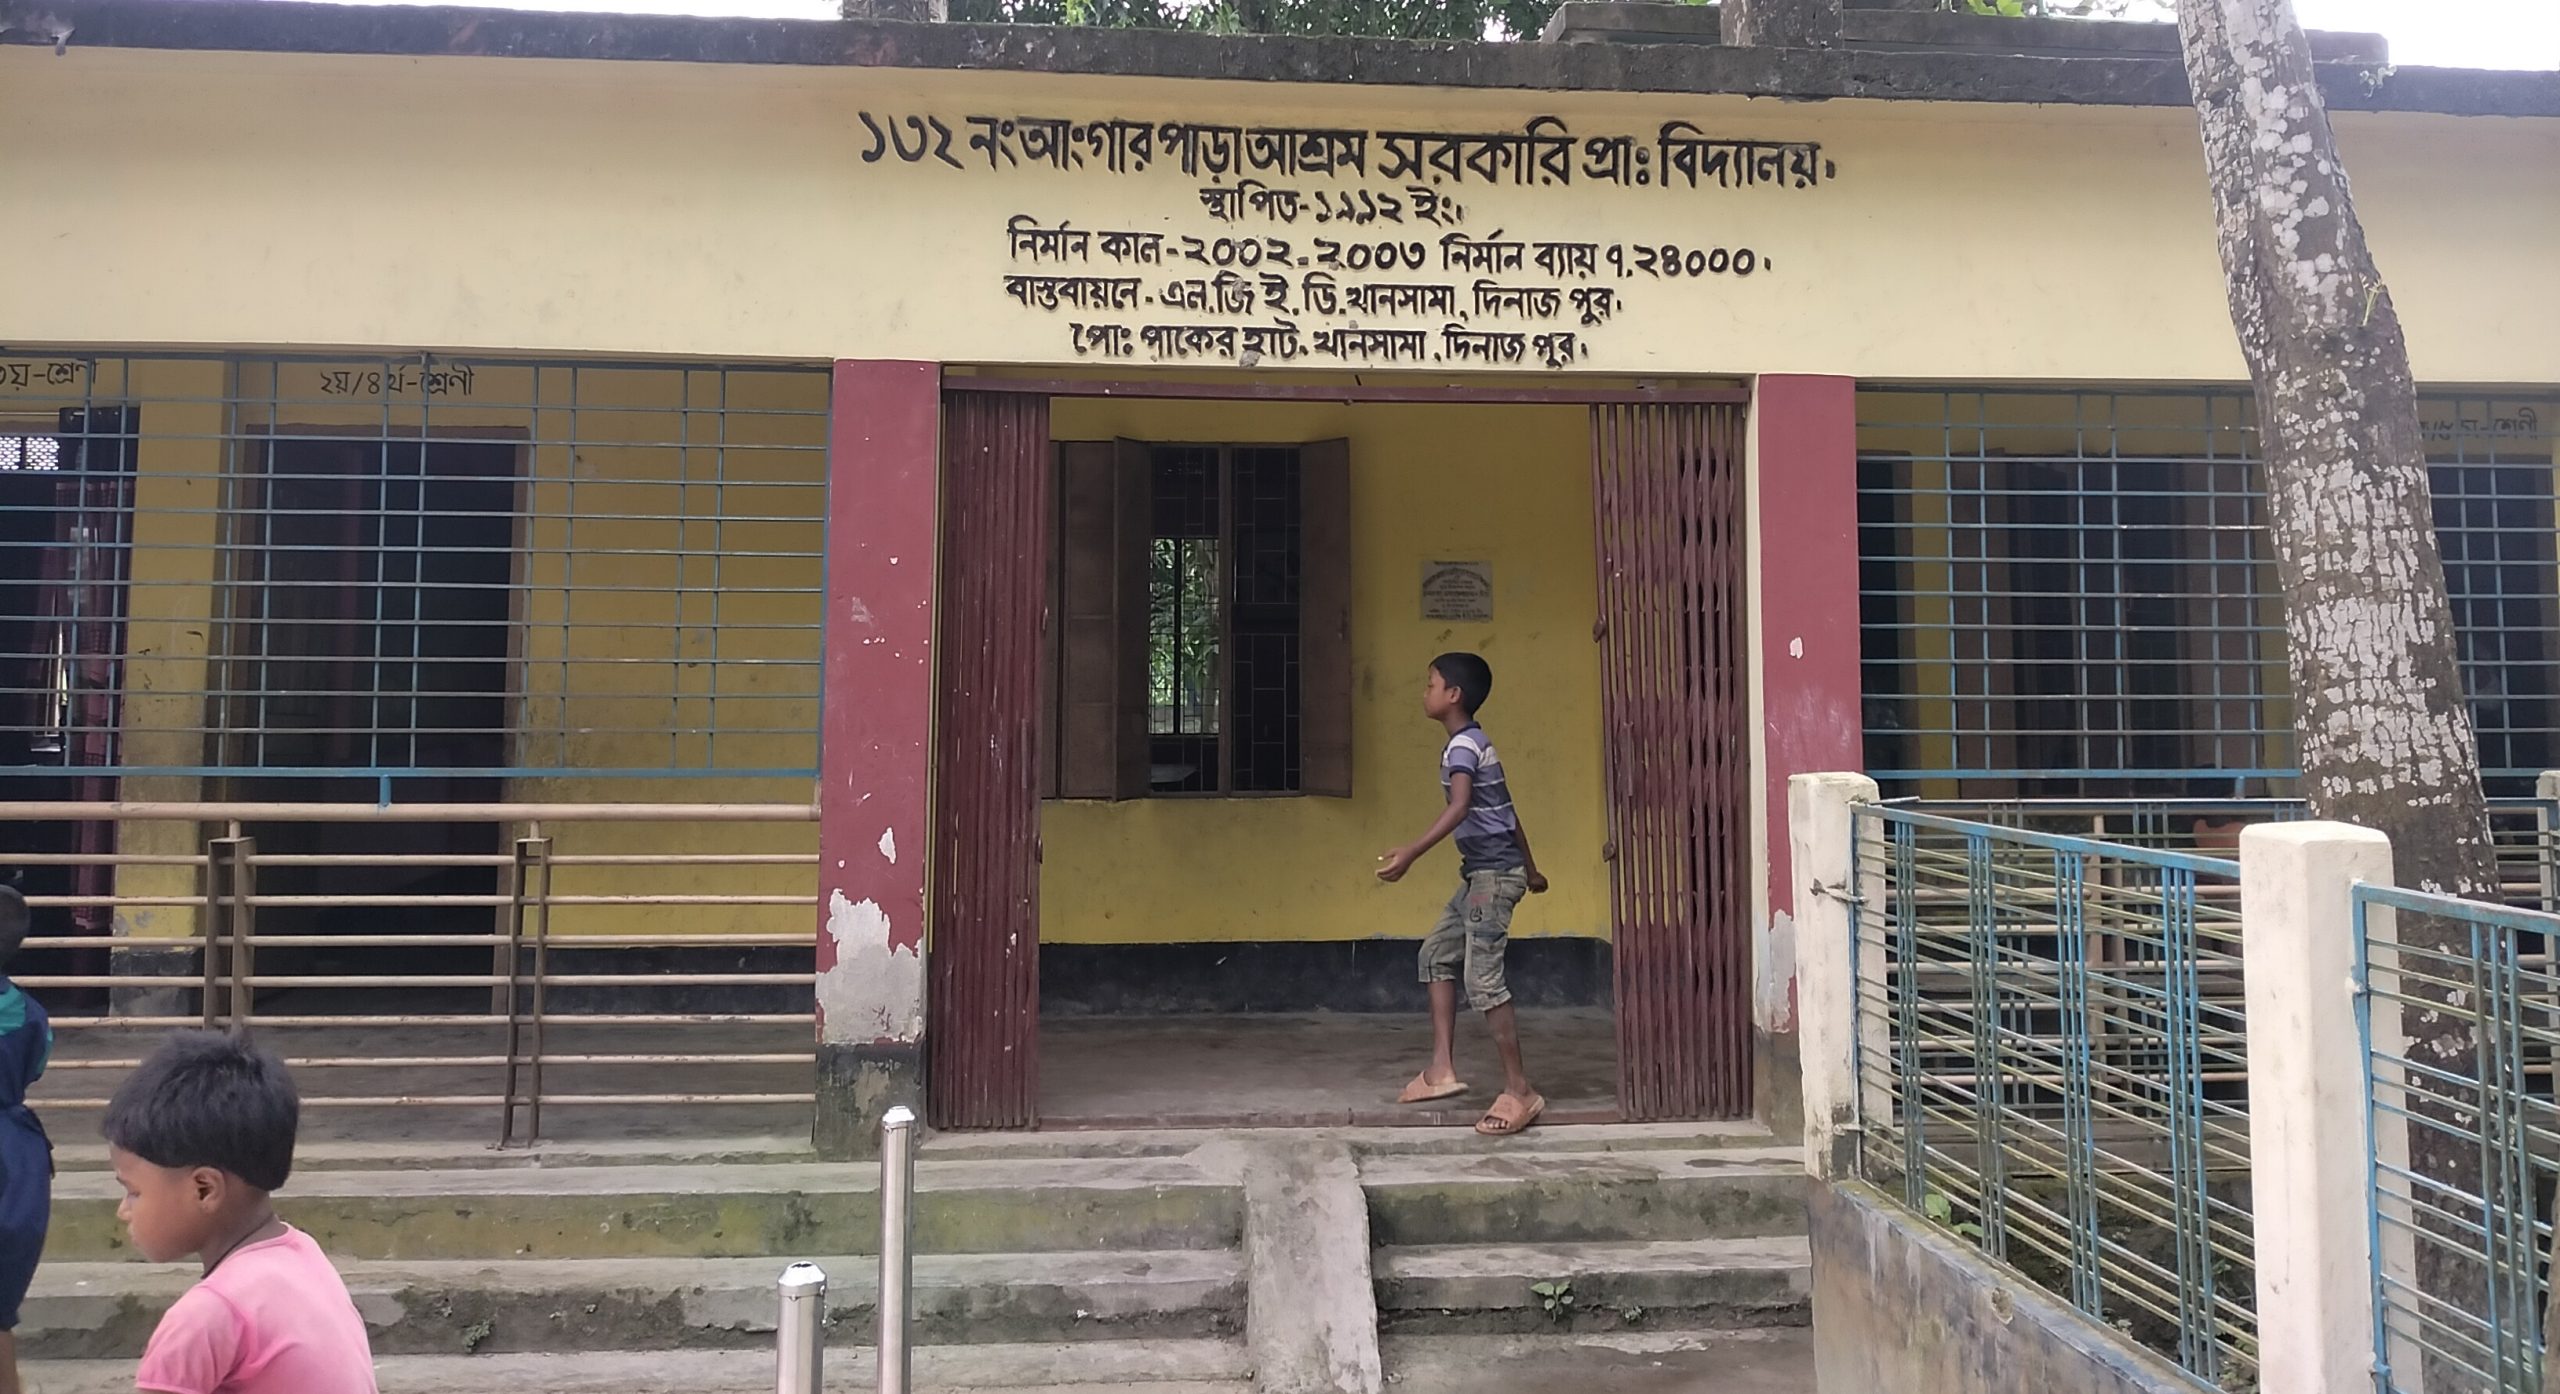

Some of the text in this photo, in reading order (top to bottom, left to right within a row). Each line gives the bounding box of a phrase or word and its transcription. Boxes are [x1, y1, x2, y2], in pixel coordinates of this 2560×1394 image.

[857, 111, 966, 170] ১৩২
[1375, 114, 1579, 187] সরকারি
[1006, 213, 1092, 264] নির্মান
[1438, 231, 1527, 276] নির্মান
